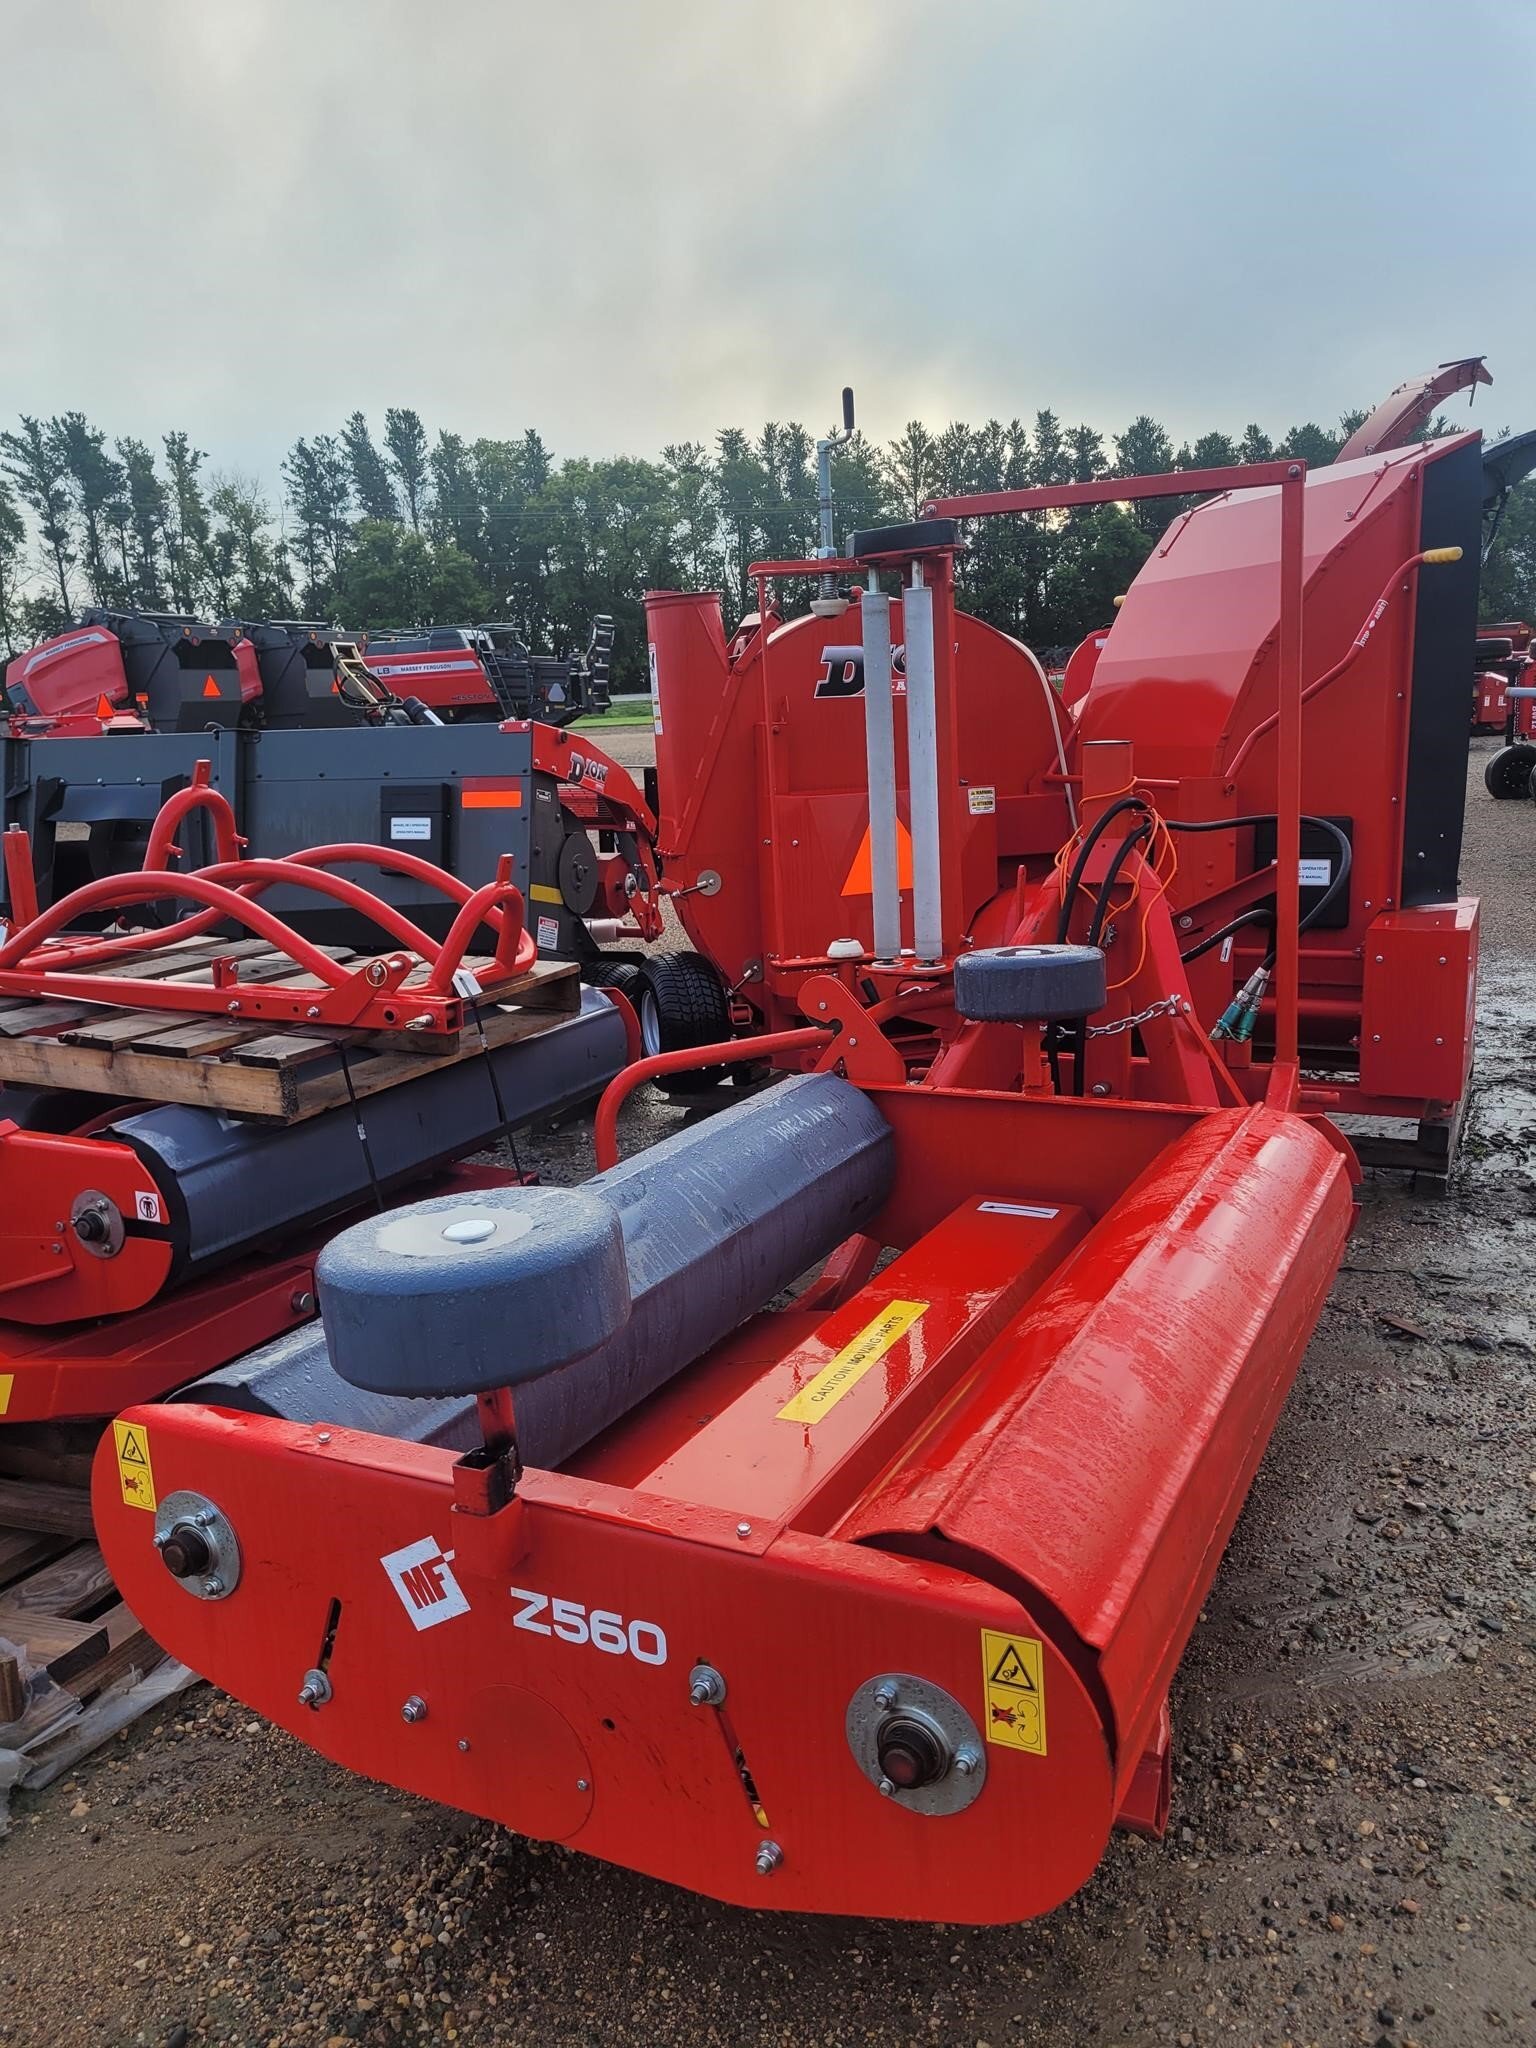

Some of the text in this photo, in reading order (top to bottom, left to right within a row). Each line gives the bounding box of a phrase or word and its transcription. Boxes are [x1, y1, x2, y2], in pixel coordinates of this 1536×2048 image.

[400, 664, 422, 673] MASSEY
[423, 663, 452, 671] FERGUSON
[847, 1337, 882, 1367] MOVING
[875, 1315, 904, 1339] PARTS
[399, 1550, 455, 1611] MF
[510, 1586, 667, 1665] Z560
